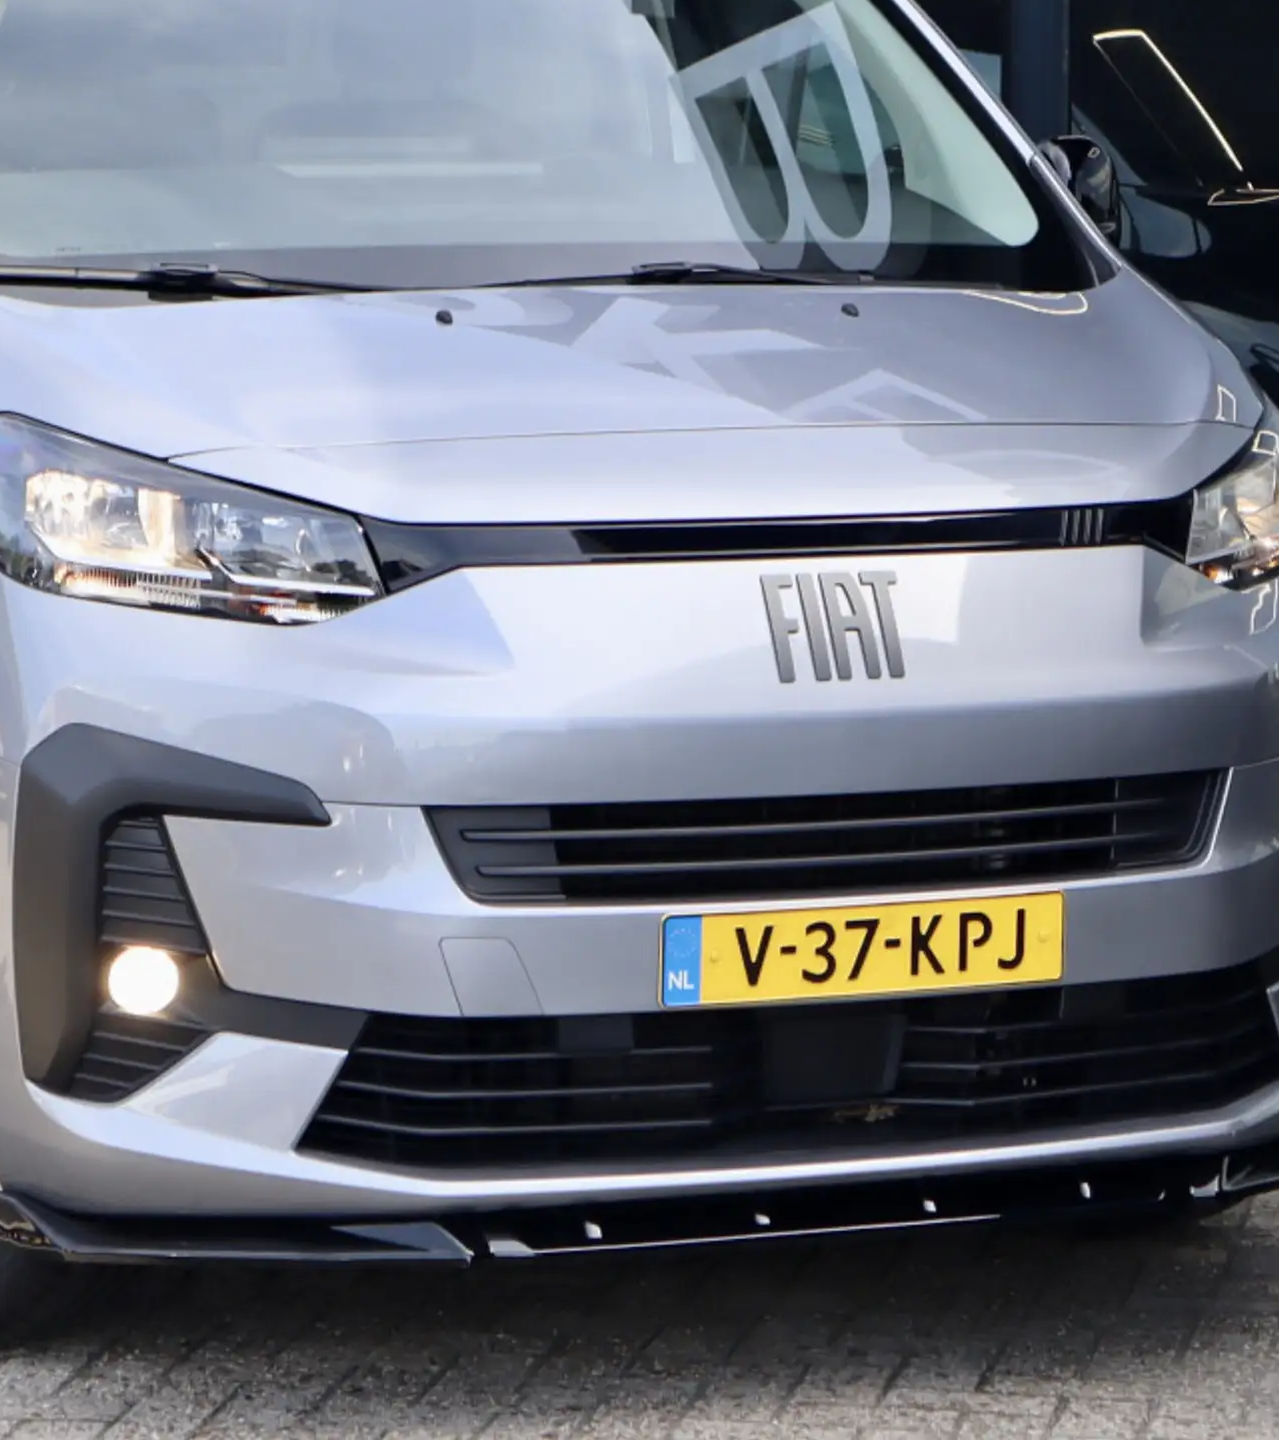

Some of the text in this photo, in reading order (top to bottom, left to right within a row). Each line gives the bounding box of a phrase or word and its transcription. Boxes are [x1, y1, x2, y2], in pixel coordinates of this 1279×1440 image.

[760, 571, 905, 683] FIAT
[668, 909, 1027, 991] NL V-37-KPJ
